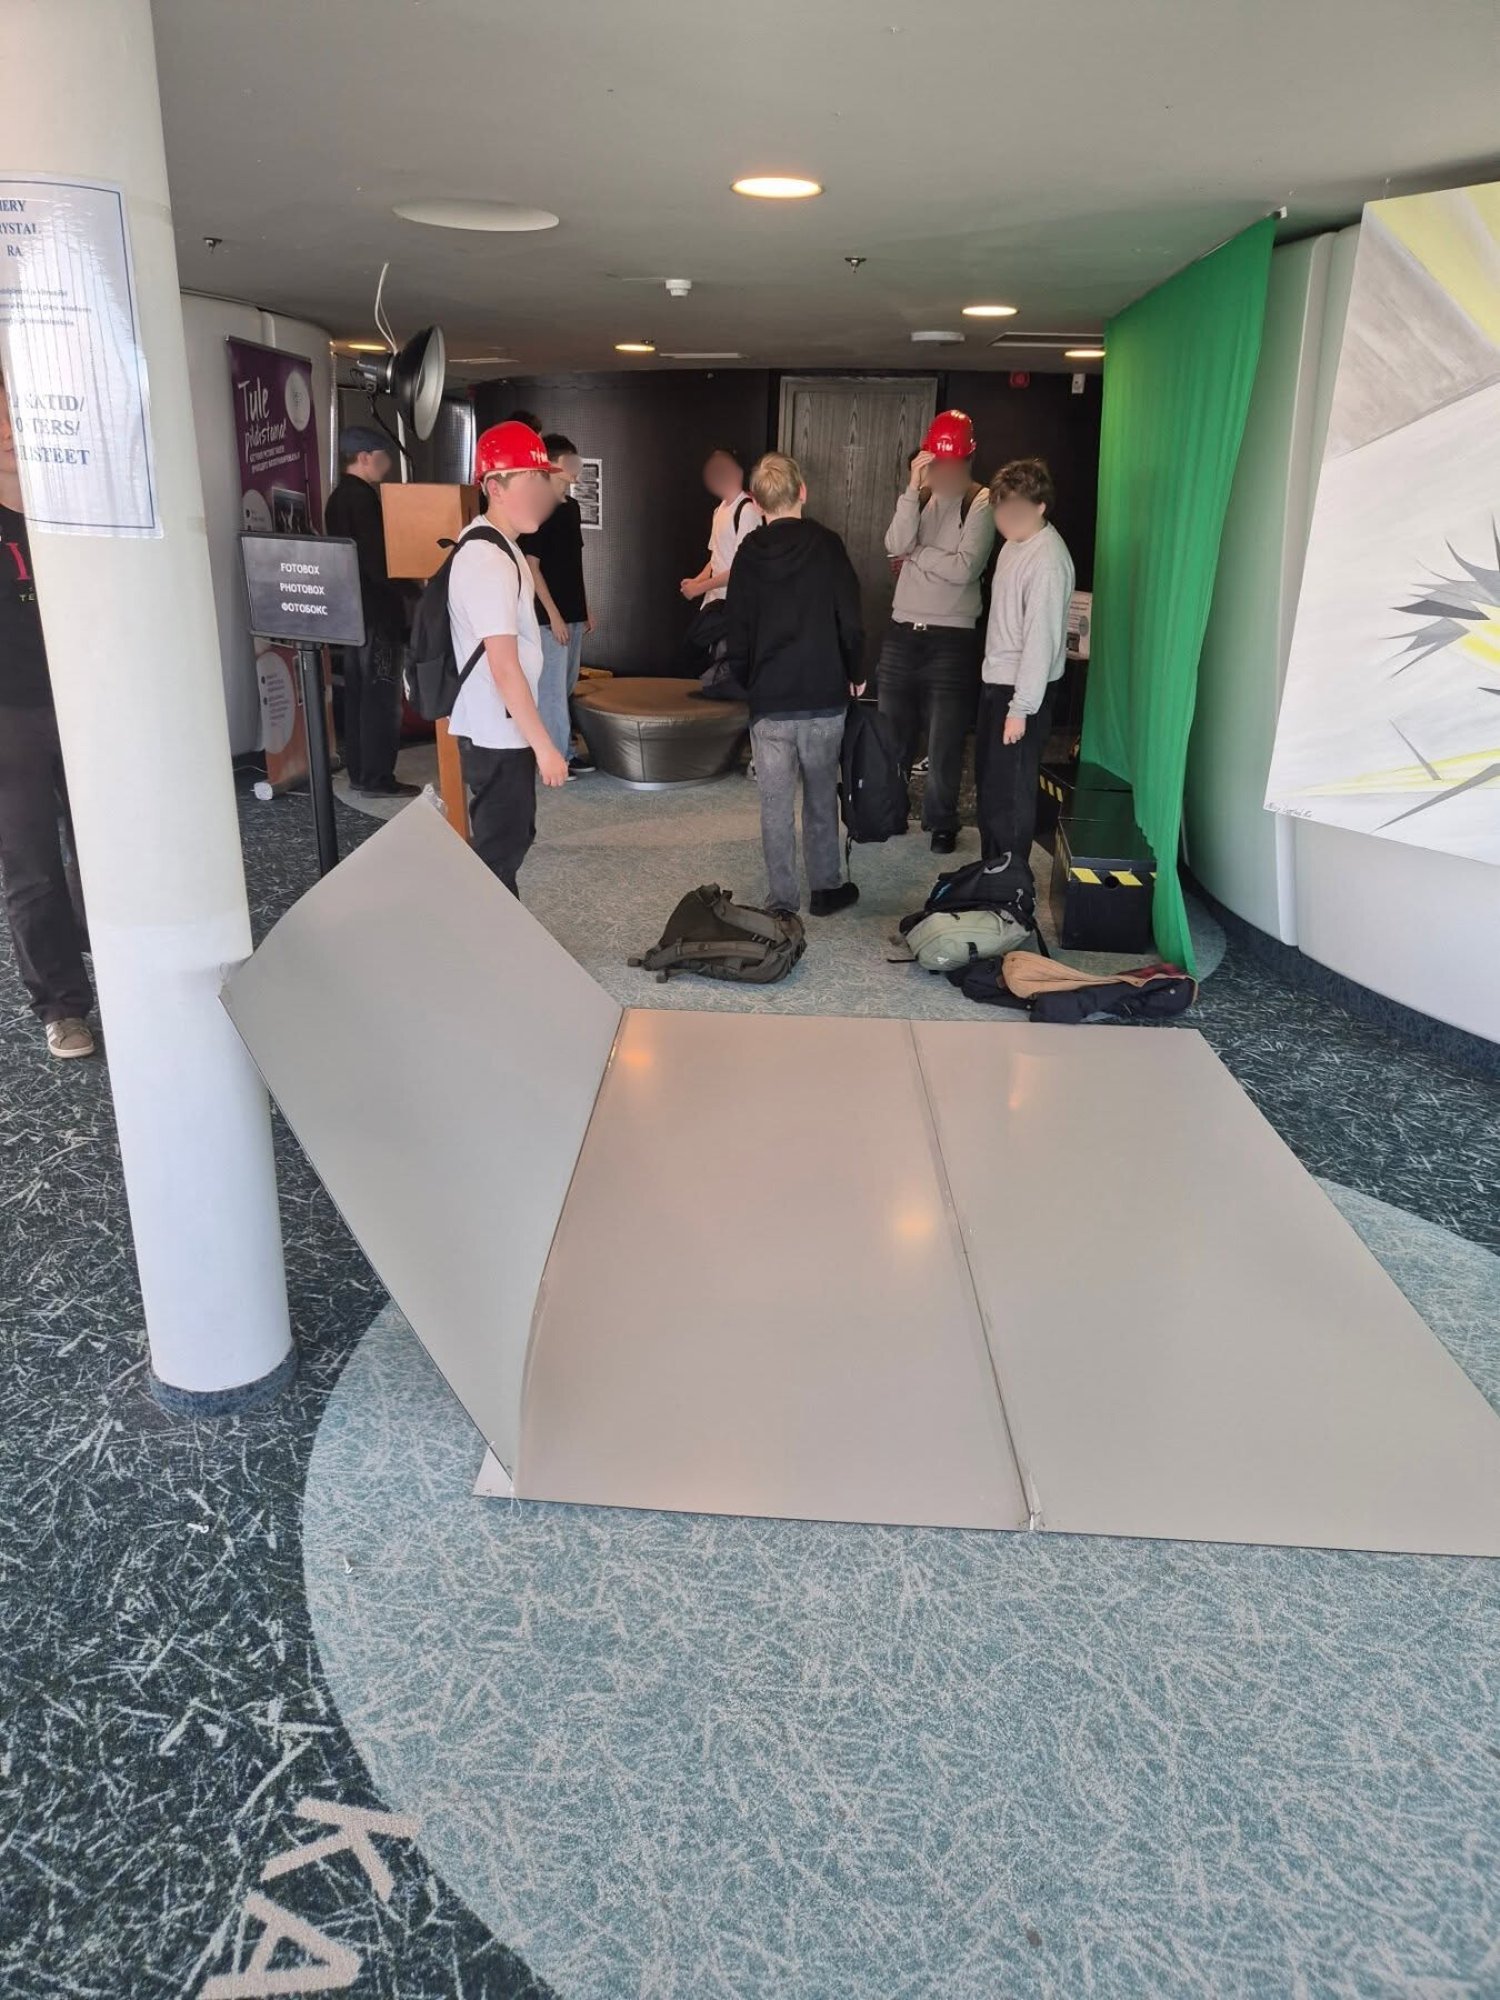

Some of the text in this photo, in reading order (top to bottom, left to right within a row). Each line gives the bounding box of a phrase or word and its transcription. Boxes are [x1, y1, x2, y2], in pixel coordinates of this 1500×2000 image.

[238, 376, 270, 422] Tule
[280, 562, 320, 575] FOTOBOX
[279, 582, 325, 596] PHOTOBOX
[281, 602, 328, 616] ФОТОБОКС
